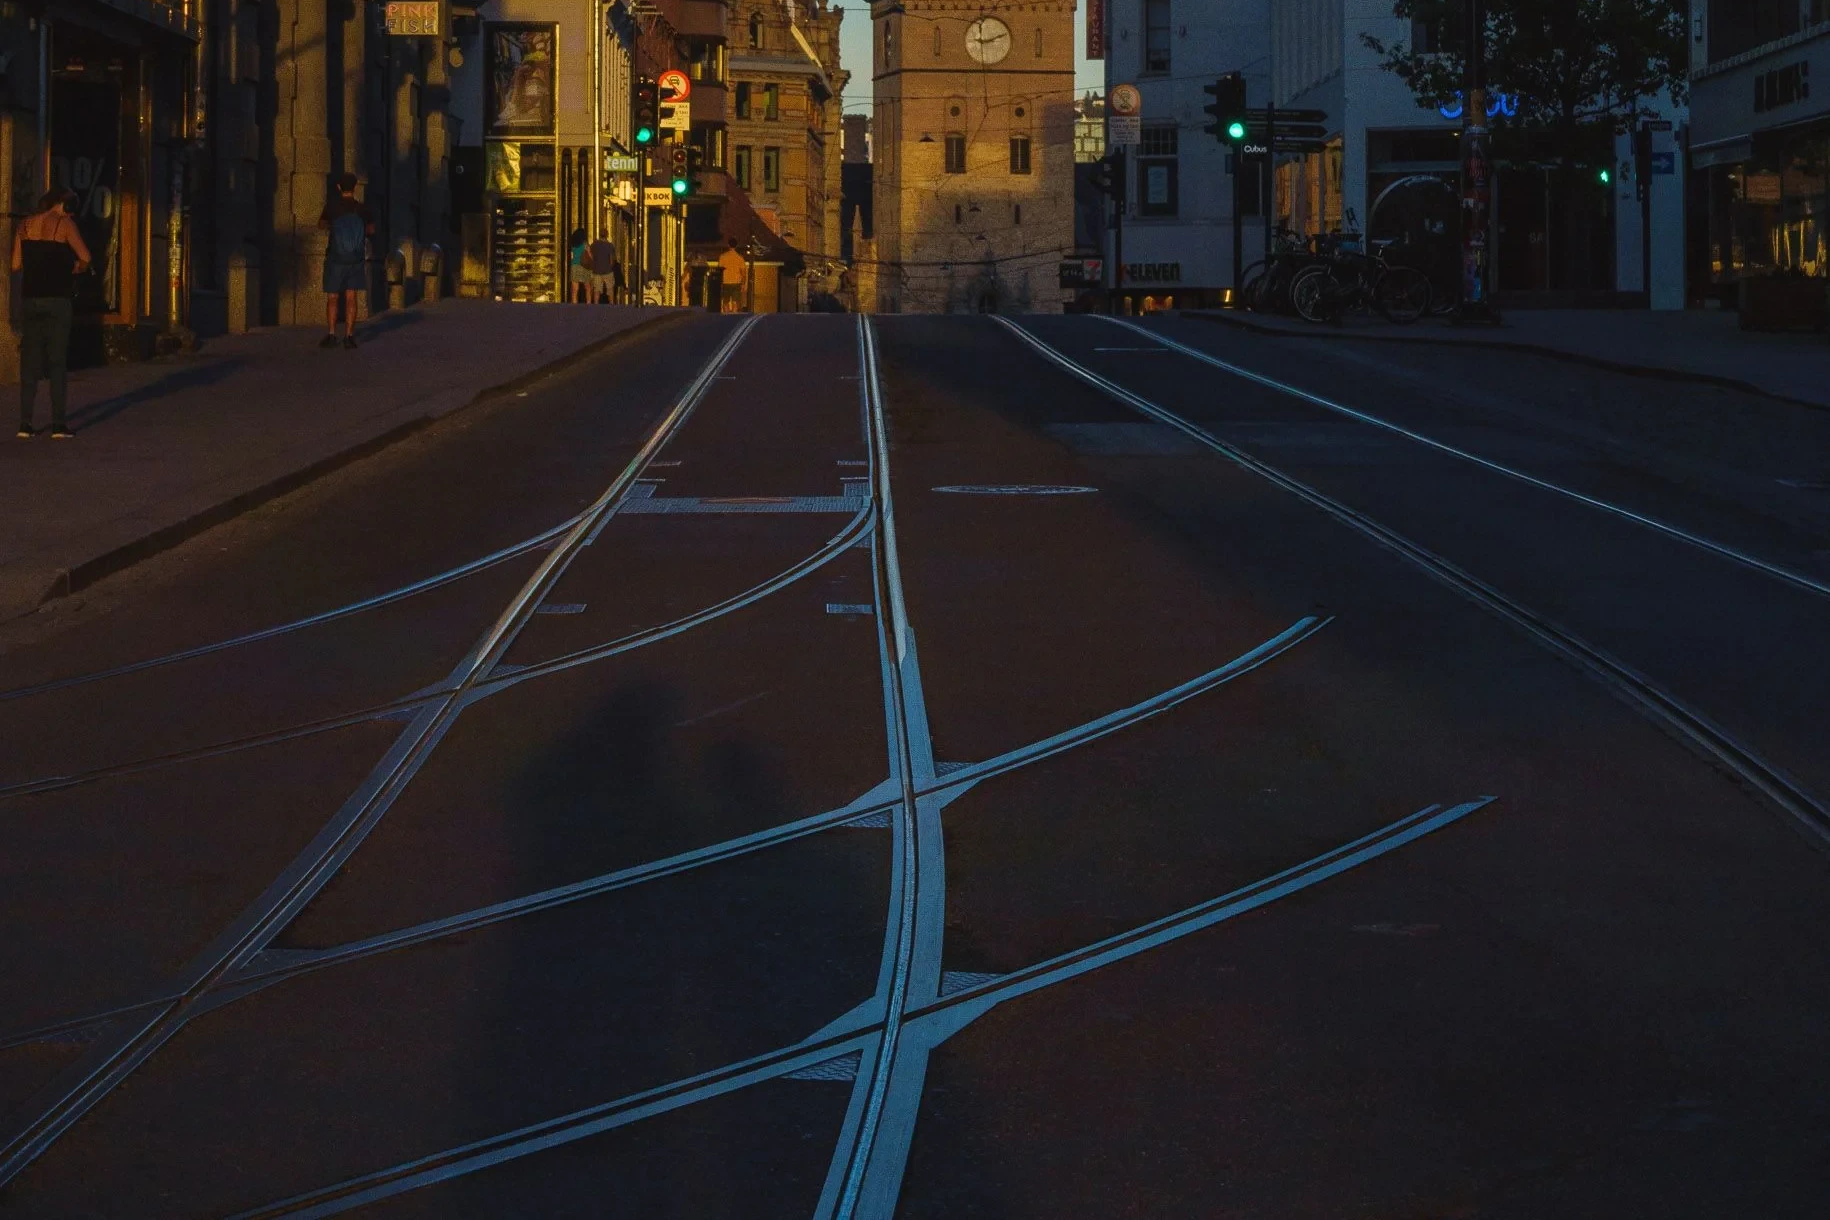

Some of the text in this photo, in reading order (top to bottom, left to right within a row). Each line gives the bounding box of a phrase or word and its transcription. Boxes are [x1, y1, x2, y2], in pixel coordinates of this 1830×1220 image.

[387, 4, 435, 17] PINK
[387, 19, 436, 33] FISH
[1243, 143, 1267, 154] Cubus
